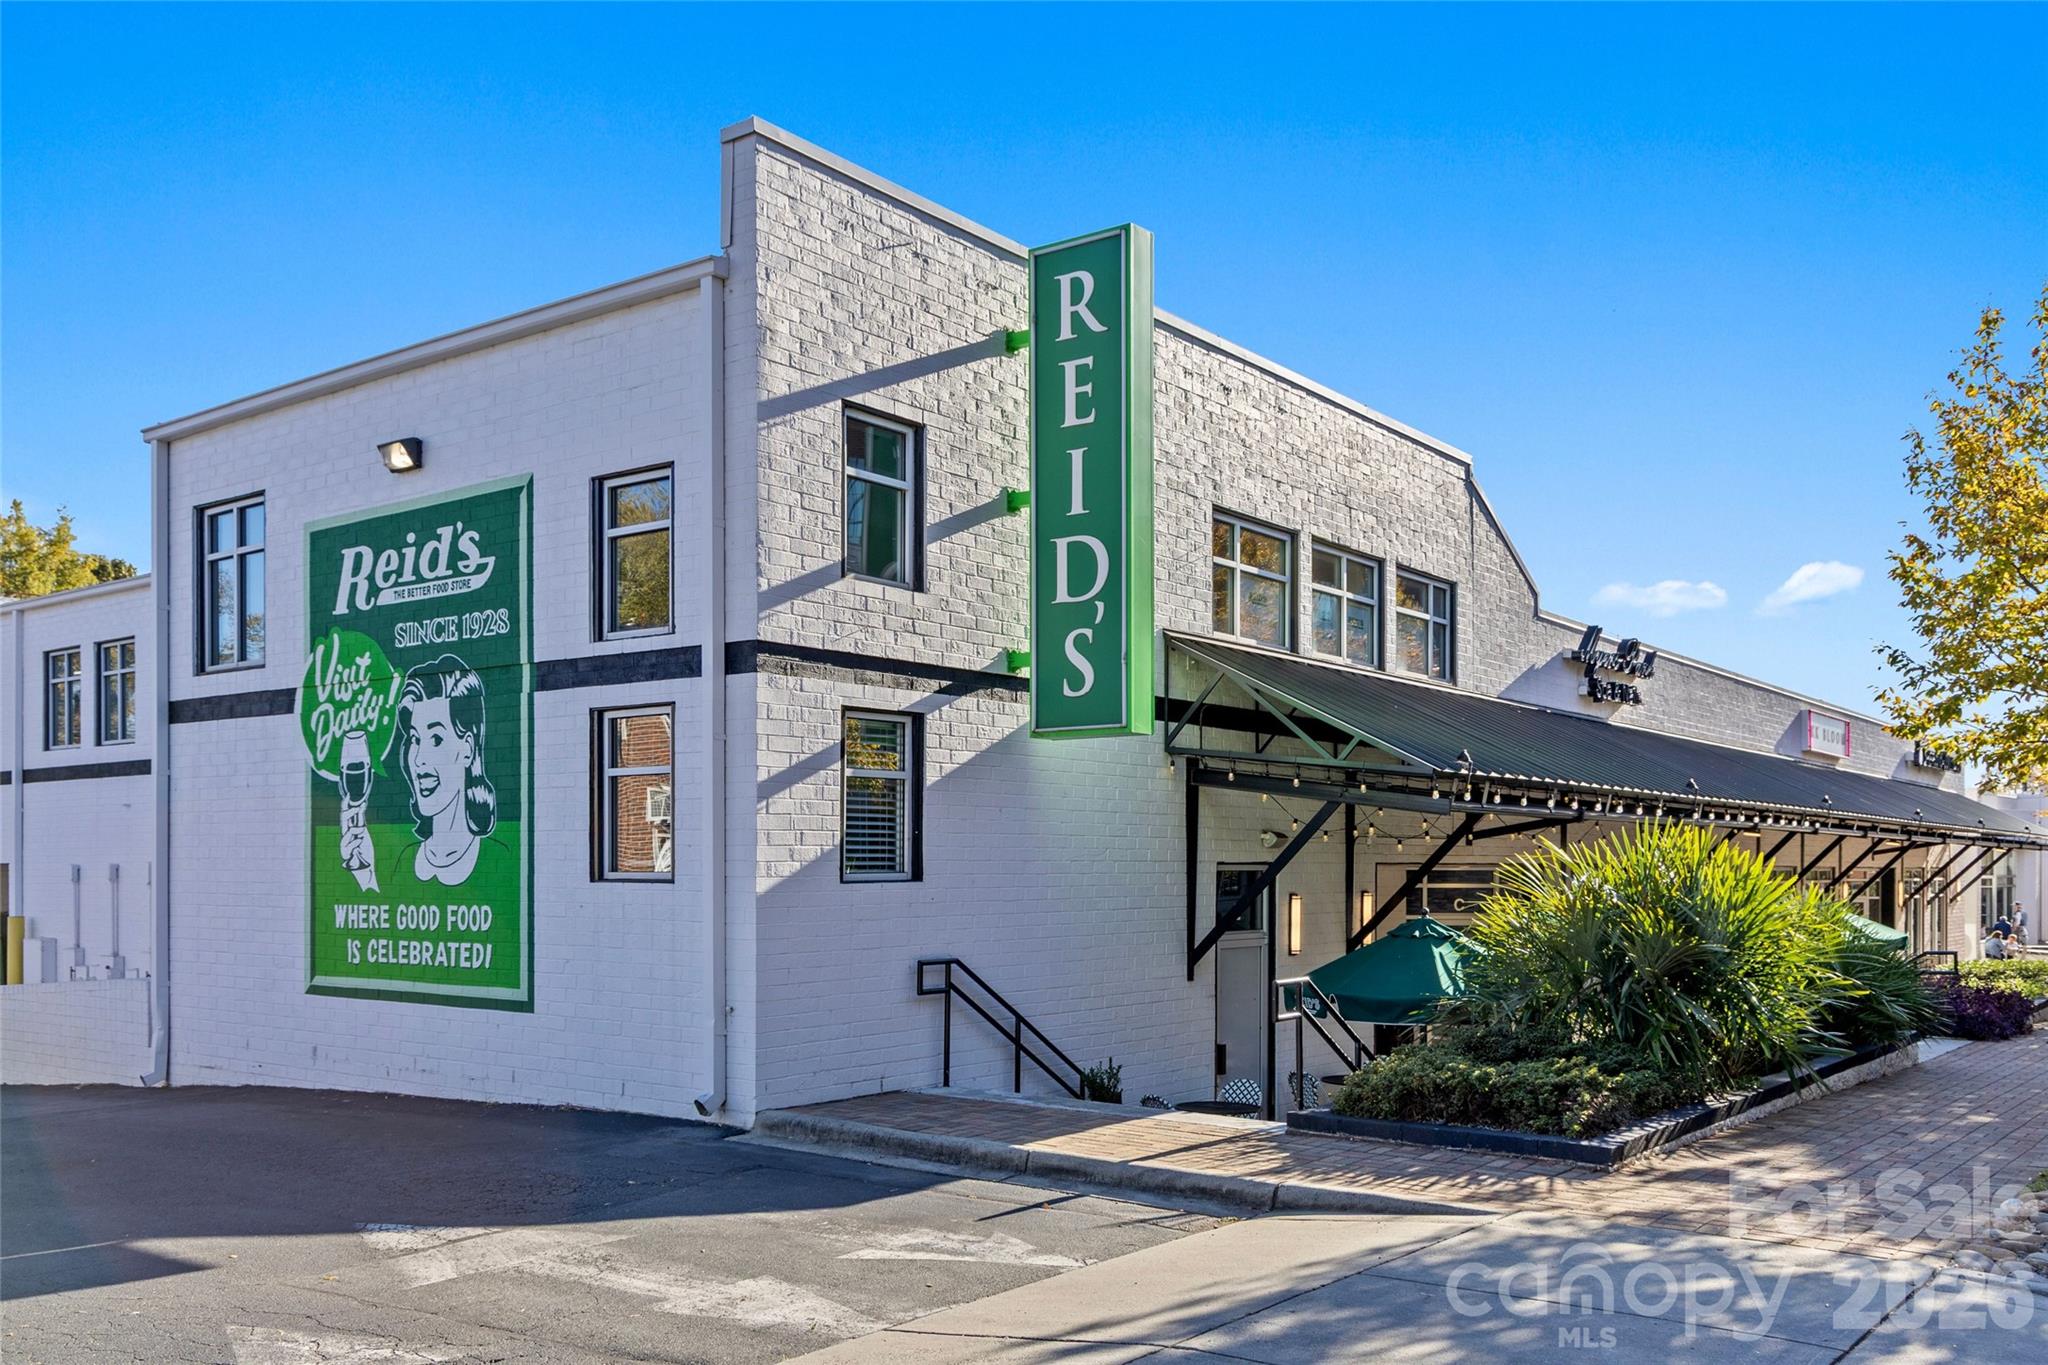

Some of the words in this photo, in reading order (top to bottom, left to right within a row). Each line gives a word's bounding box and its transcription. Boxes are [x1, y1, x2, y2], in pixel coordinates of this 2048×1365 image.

[1049, 269, 1110, 698] REID'S
[332, 521, 486, 615] Reid's
[393, 588, 405, 600] THE
[407, 585, 431, 598] BETTER
[432, 581, 449, 595] FOOD
[450, 578, 472, 592] STORE
[394, 615, 458, 648] SINCE
[462, 607, 510, 639] 1928
[315, 632, 372, 702] Visit
[310, 672, 401, 762] Daily!
[334, 904, 390, 929] WHERE
[396, 904, 440, 930] GOOD
[447, 904, 493, 932] FOOD
[347, 938, 361, 965] IS
[367, 939, 493, 969] CELEBRATED!
